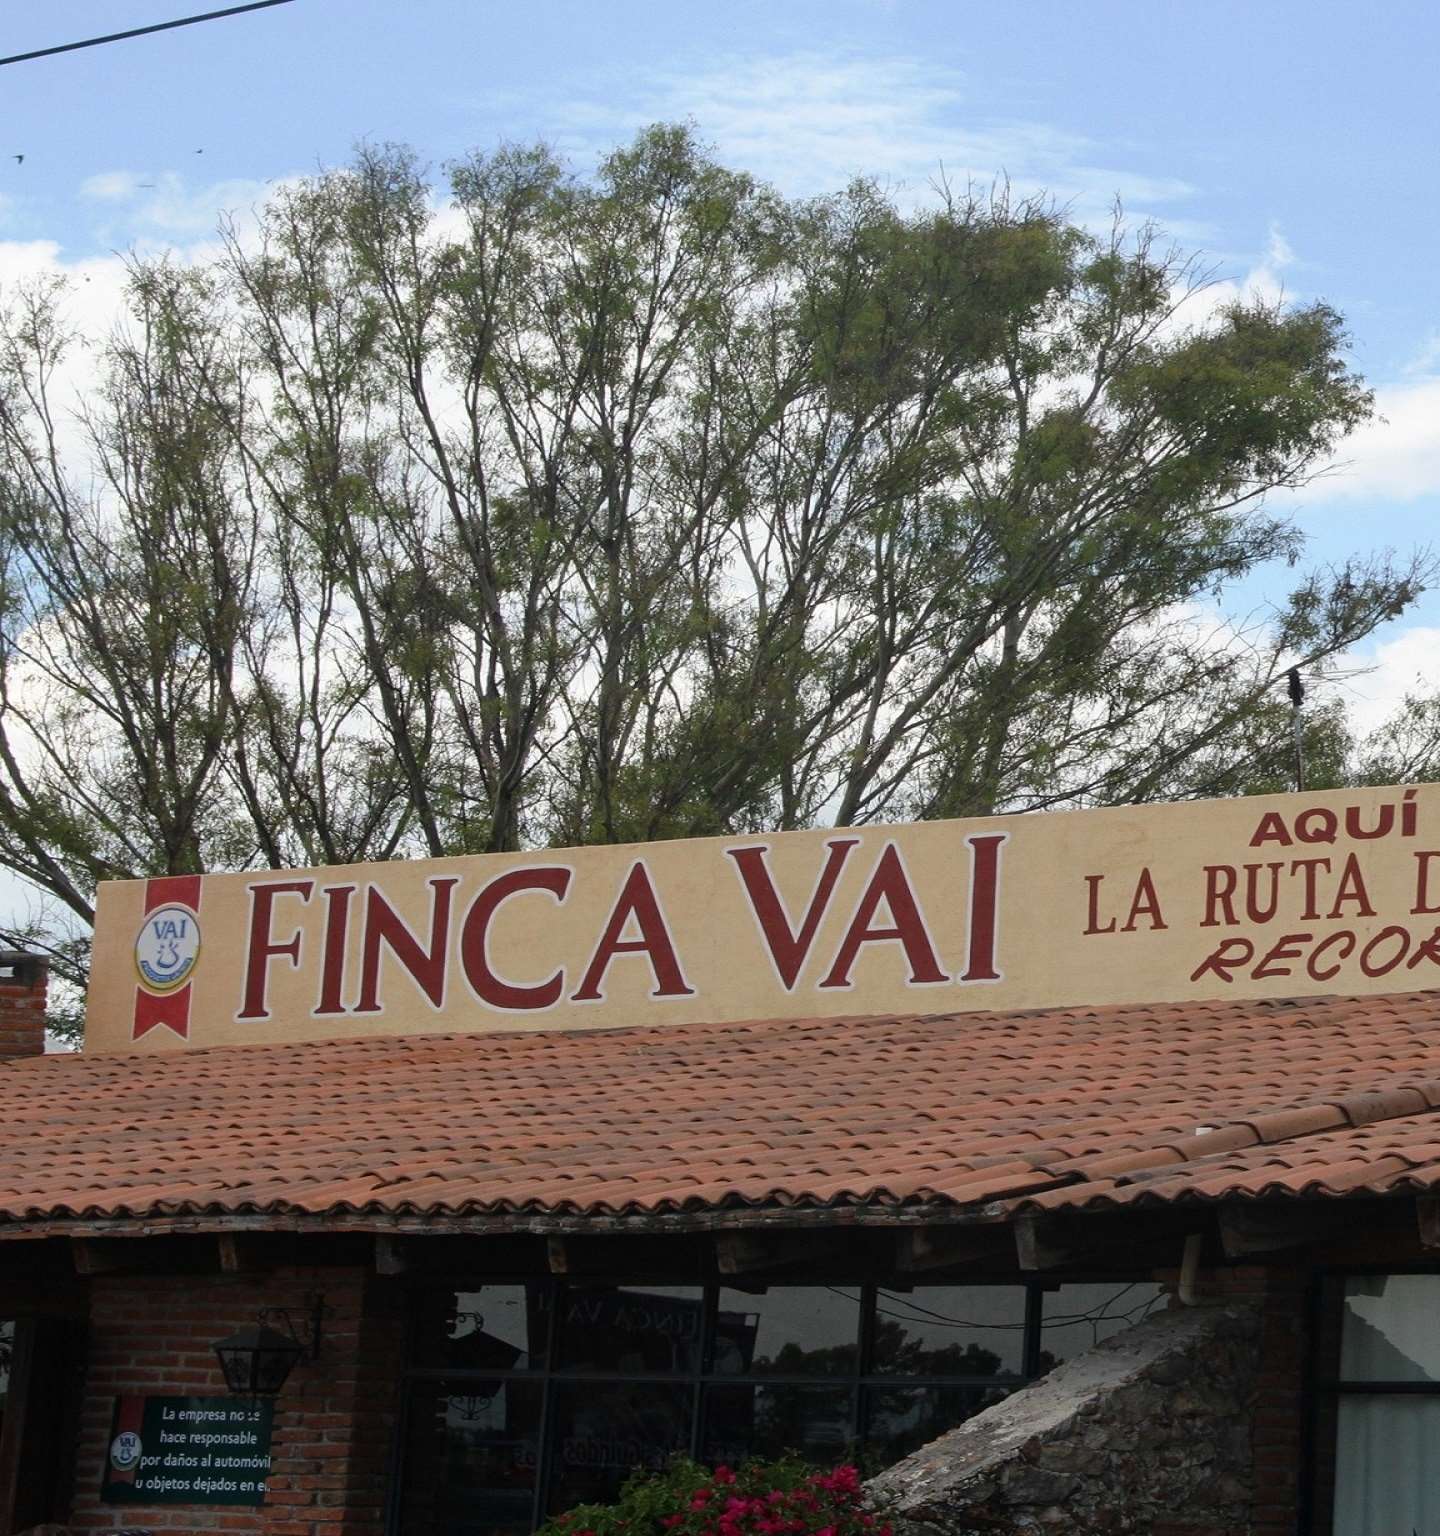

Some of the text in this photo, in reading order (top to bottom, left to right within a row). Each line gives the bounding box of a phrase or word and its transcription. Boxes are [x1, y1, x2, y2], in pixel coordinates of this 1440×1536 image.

[1248, 789, 1417, 847] AQUÍ
[1083, 867, 1168, 936] LA
[1200, 852, 1377, 927] RUTA
[153, 919, 187, 939] VAI
[237, 835, 1006, 1019] FINCA VAI
[163, 1407, 175, 1419] La
[178, 1412, 226, 1424] empresa
[230, 1412, 244, 1420] no
[160, 1430, 257, 1447] hace responsable
[139, 1453, 271, 1469] por daños al automóvil
[135, 1479, 143, 1489] u
[146, 1476, 190, 1492] objetos
[193, 1477, 236, 1493] dejados
[240, 1481, 254, 1491] en
